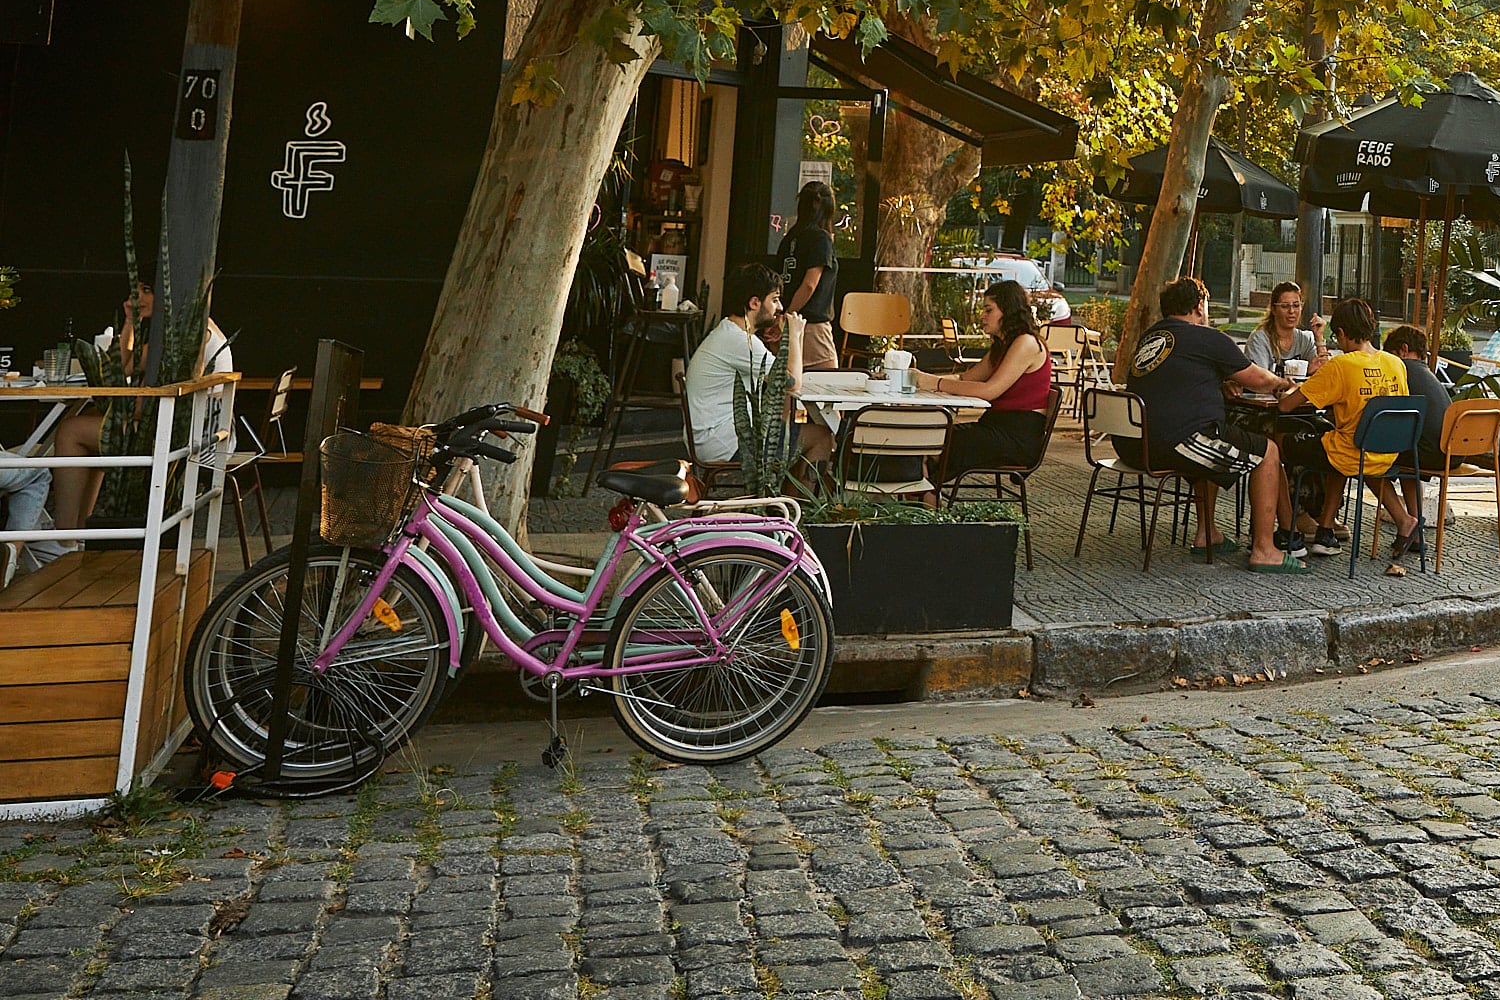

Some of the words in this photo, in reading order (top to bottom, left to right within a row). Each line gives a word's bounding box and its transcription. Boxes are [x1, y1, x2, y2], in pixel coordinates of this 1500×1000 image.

[184, 75, 217, 99] 70
[191, 108, 206, 131] 0
[1358, 140, 1394, 155] FEDE
[1356, 152, 1392, 167] RADO
